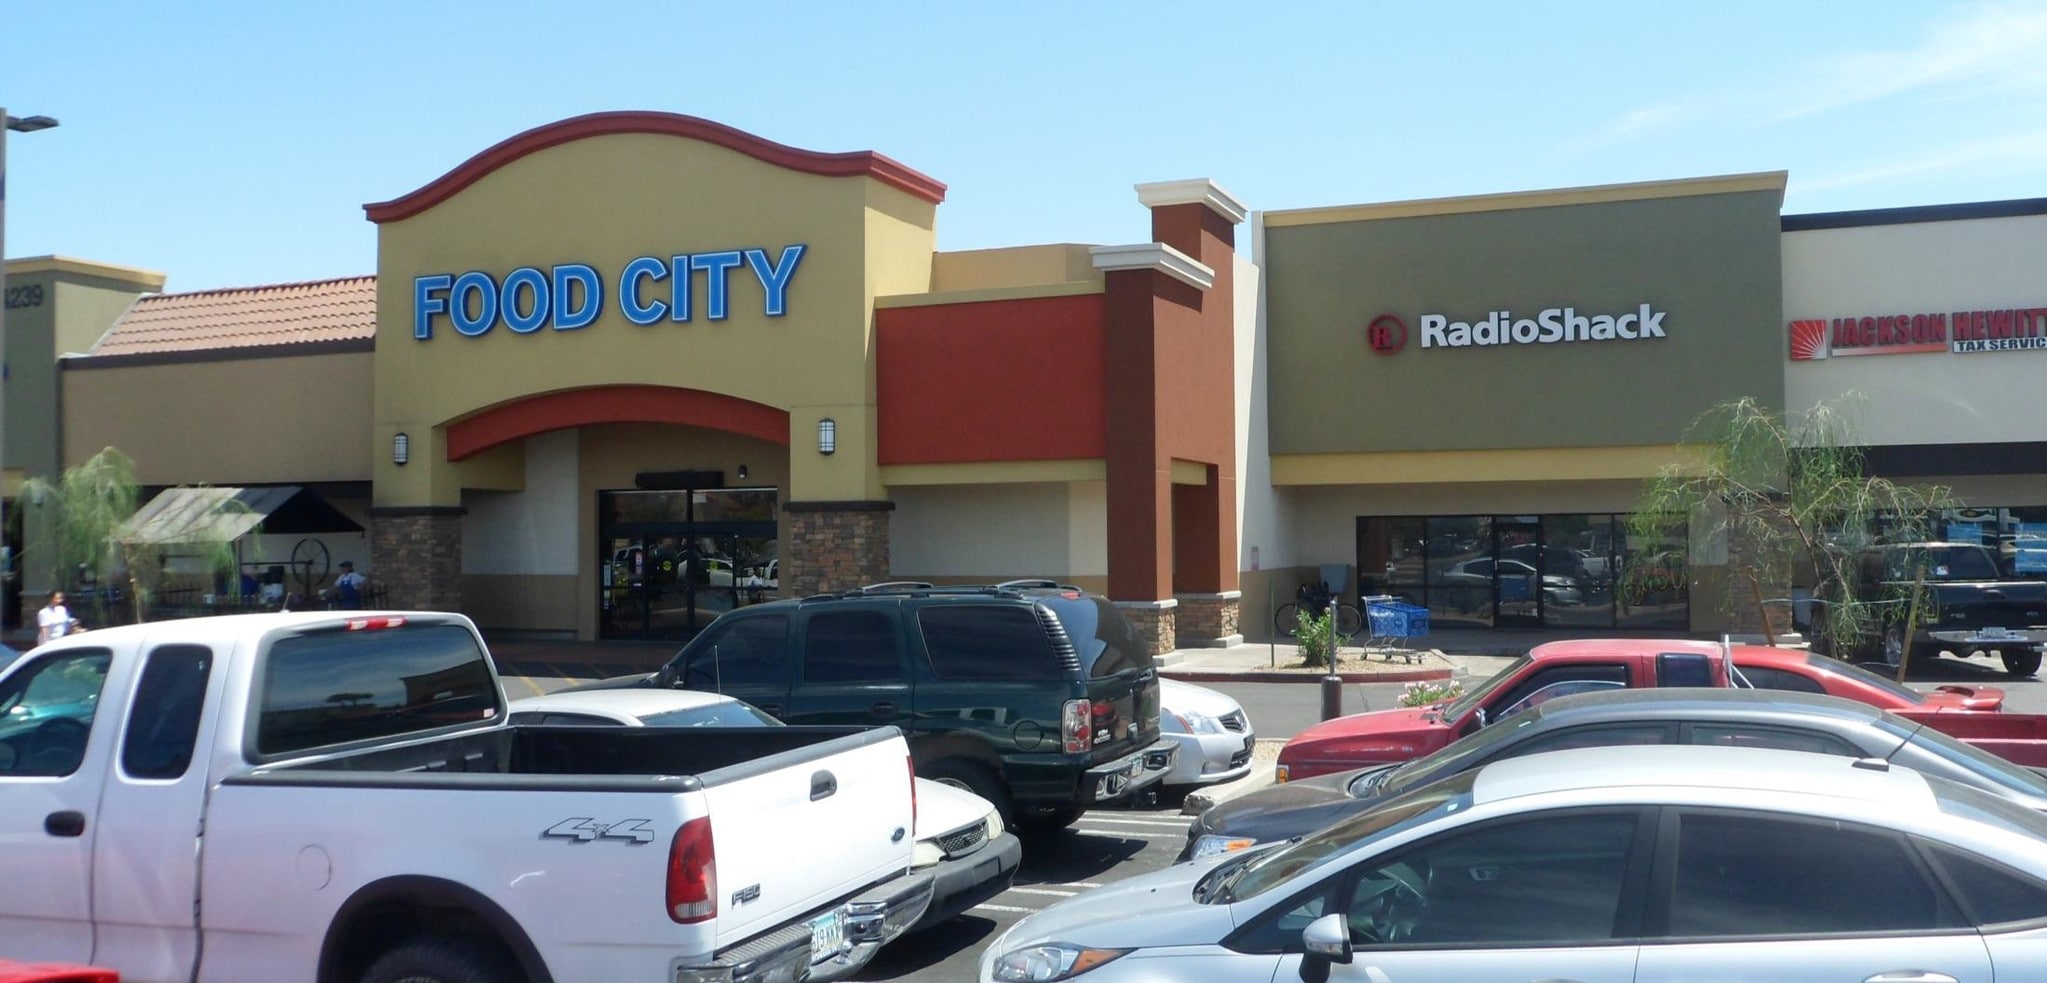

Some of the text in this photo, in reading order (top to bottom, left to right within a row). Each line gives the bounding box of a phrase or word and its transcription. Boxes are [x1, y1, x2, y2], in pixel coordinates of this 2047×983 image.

[414, 244, 807, 341] FOOD CITY
[1420, 303, 1667, 348] RadioShack
[1832, 313, 1947, 347] JACKSON
[1958, 341, 1986, 352] TAX
